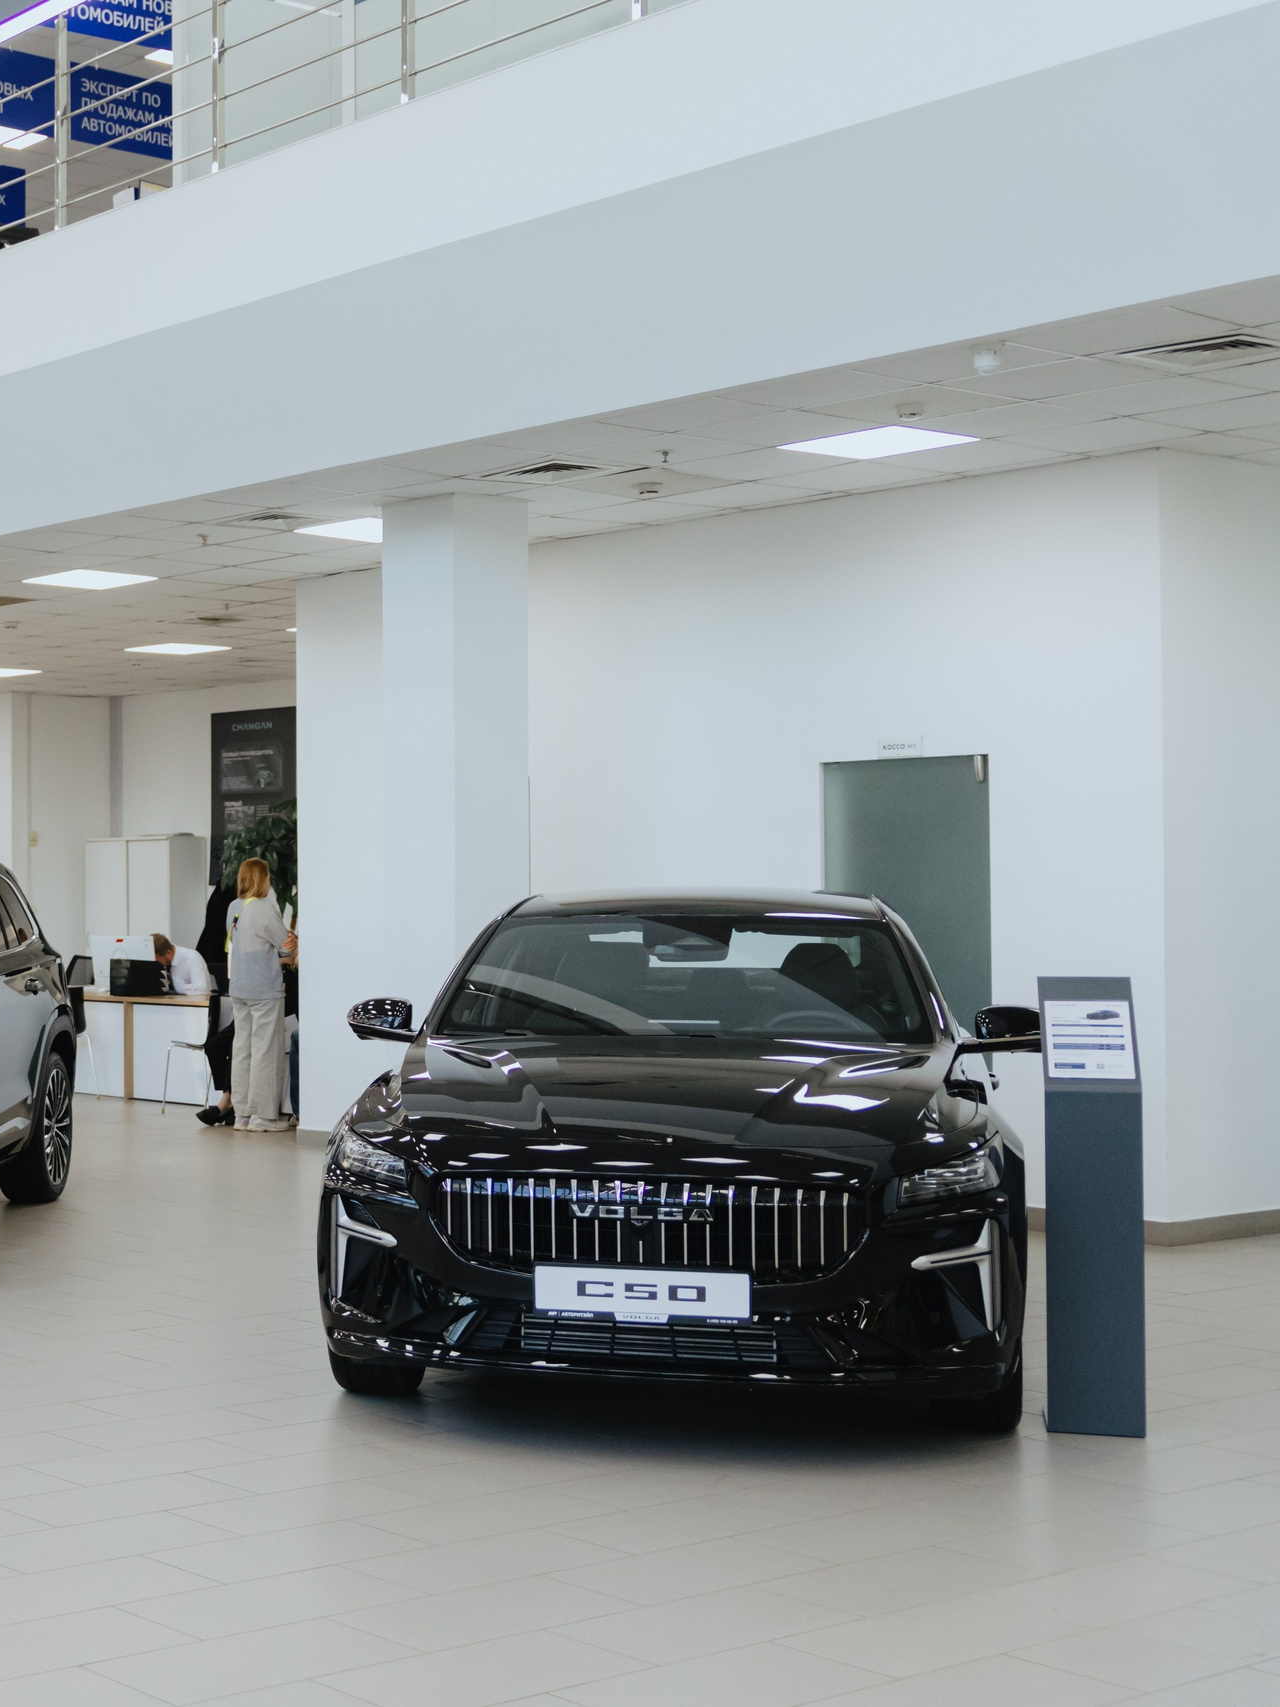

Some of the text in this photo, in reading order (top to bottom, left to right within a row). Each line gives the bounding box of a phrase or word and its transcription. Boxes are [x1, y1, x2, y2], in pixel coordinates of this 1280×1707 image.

[81, 78, 161, 108] ЭКСПЕРТ ПО
[81, 97, 155, 124] ПРОДАЖАМ
[231, 721, 273, 732] CHANGAN
[570, 1203, 714, 1221] VOLGA
[576, 1280, 706, 1302] C50
